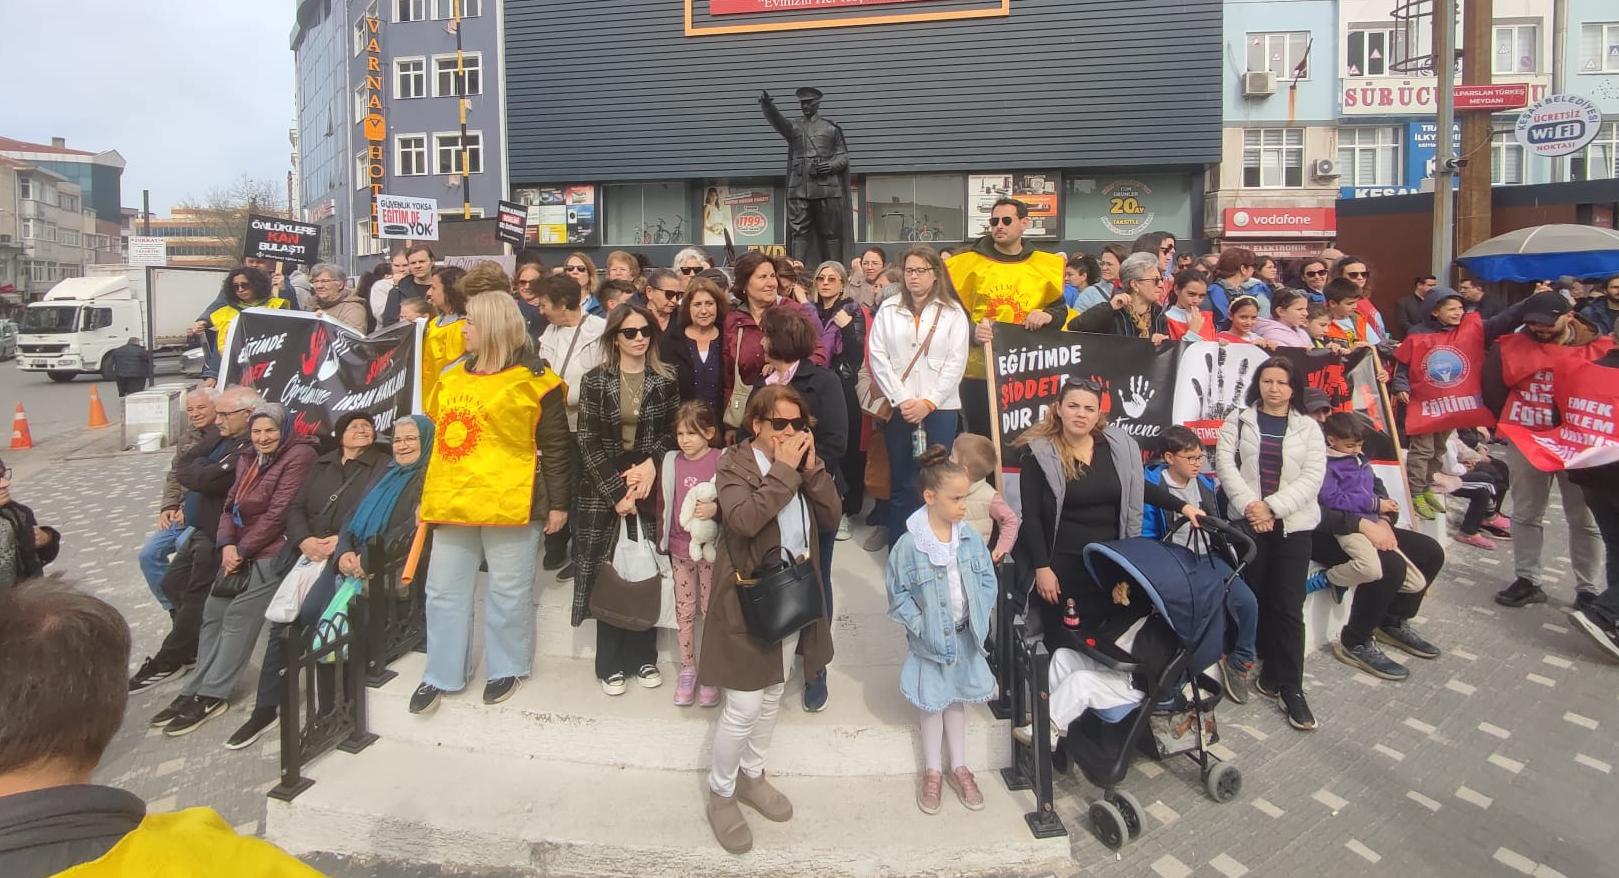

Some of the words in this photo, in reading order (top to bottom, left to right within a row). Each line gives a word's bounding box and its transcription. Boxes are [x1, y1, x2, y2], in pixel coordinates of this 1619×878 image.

[367, 16, 383, 109] VARNA
[1533, 109, 1580, 123] ÜCRETSİZ
[1536, 142, 1575, 152] NOKTASI
[1110, 196, 1138, 214] 20
[251, 219, 317, 236] ÖNLÜKLERE
[1253, 213, 1311, 225] vodafone
[267, 230, 301, 244] KAN
[258, 241, 306, 255] BULAŞTI
[998, 344, 1082, 376] EĞİTİMDE
[332, 387, 377, 412] İNSAN
[374, 367, 408, 404] HAKLARI
[1421, 395, 1477, 418] Eğitim
[1568, 396, 1613, 418] EMEK
[1002, 407, 1033, 434] DUR
[1105, 416, 1163, 437] etmene
